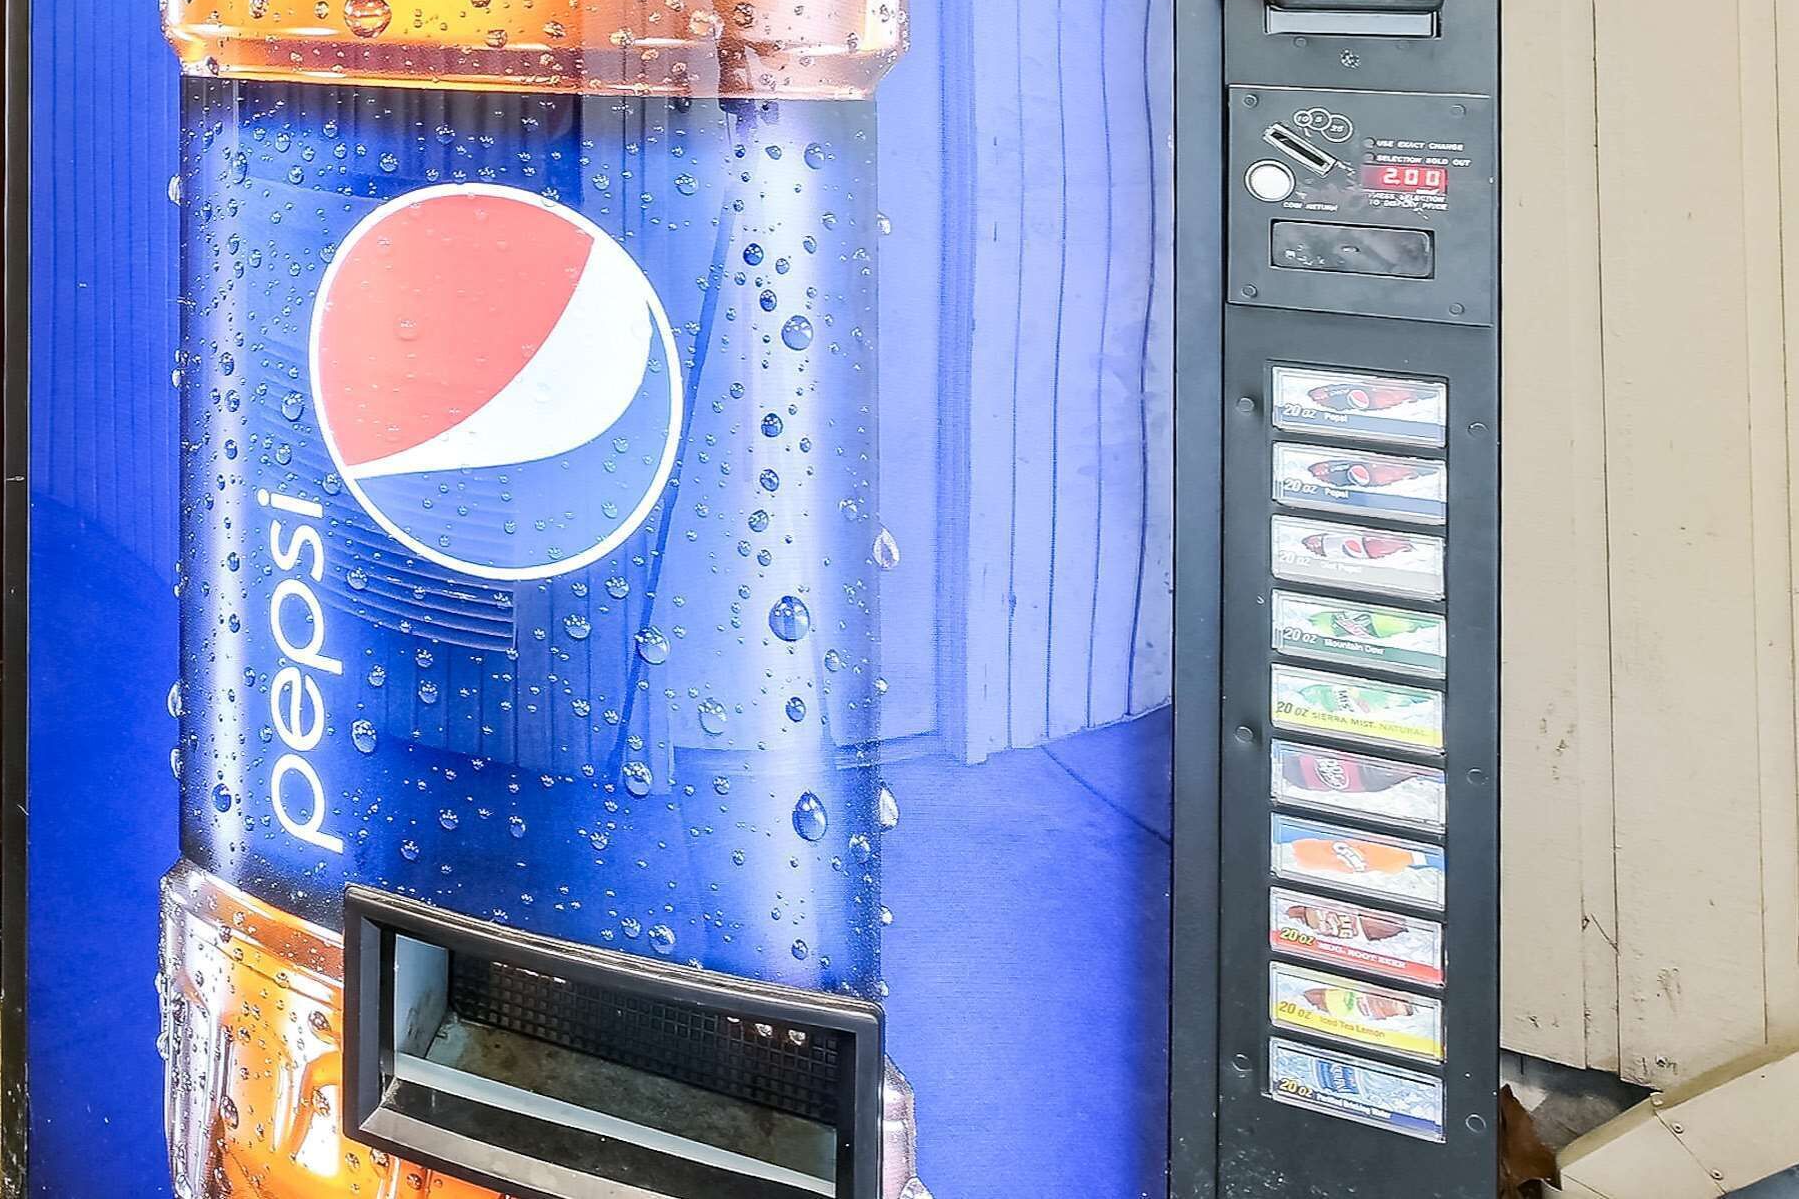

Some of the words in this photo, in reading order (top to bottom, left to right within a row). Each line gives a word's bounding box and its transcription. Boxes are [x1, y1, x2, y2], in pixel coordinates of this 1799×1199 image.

[1297, 115, 1309, 123] 10
[1330, 124, 1344, 132] 25
[1376, 140, 1394, 148] USE
[1397, 140, 1426, 150] EXACT
[1428, 142, 1464, 151] CHANGE
[1376, 154, 1423, 164] SELECTION
[1425, 157, 1449, 165] SOLD
[1452, 159, 1472, 167] OUT
[1283, 201, 1303, 209] COIN
[1305, 203, 1338, 211] RETURN
[1369, 199, 1381, 207] TO
[1422, 202, 1448, 211] PRICE
[1399, 193, 1446, 203] SELECTION
[1283, 403, 1301, 417] 20
[1302, 408, 1318, 419] oz
[1324, 412, 1349, 423] Pepsi
[1283, 478, 1302, 492] 20
[1302, 484, 1319, 495] oz
[1324, 487, 1349, 499] Pepsi
[1279, 551, 1294, 565] 20
[1296, 555, 1311, 566] oz
[1283, 627, 1300, 641] 20
[1302, 634, 1317, 644] oz
[1323, 638, 1364, 652] Mountain
[1364, 645, 1386, 655] Dew
[257, 488, 344, 854] pepsi
[1276, 701, 1292, 714] 20
[1311, 711, 1348, 725] SIERRA
[1280, 927, 1298, 941] 20
[1298, 934, 1316, 946] oz
[1279, 1000, 1296, 1014] 20
[1297, 1008, 1312, 1020] oz
[1339, 1019, 1355, 1029] Tea
[1355, 1024, 1386, 1038] Lemon
[1279, 1078, 1297, 1092] 20
[1298, 1086, 1313, 1098] oz
